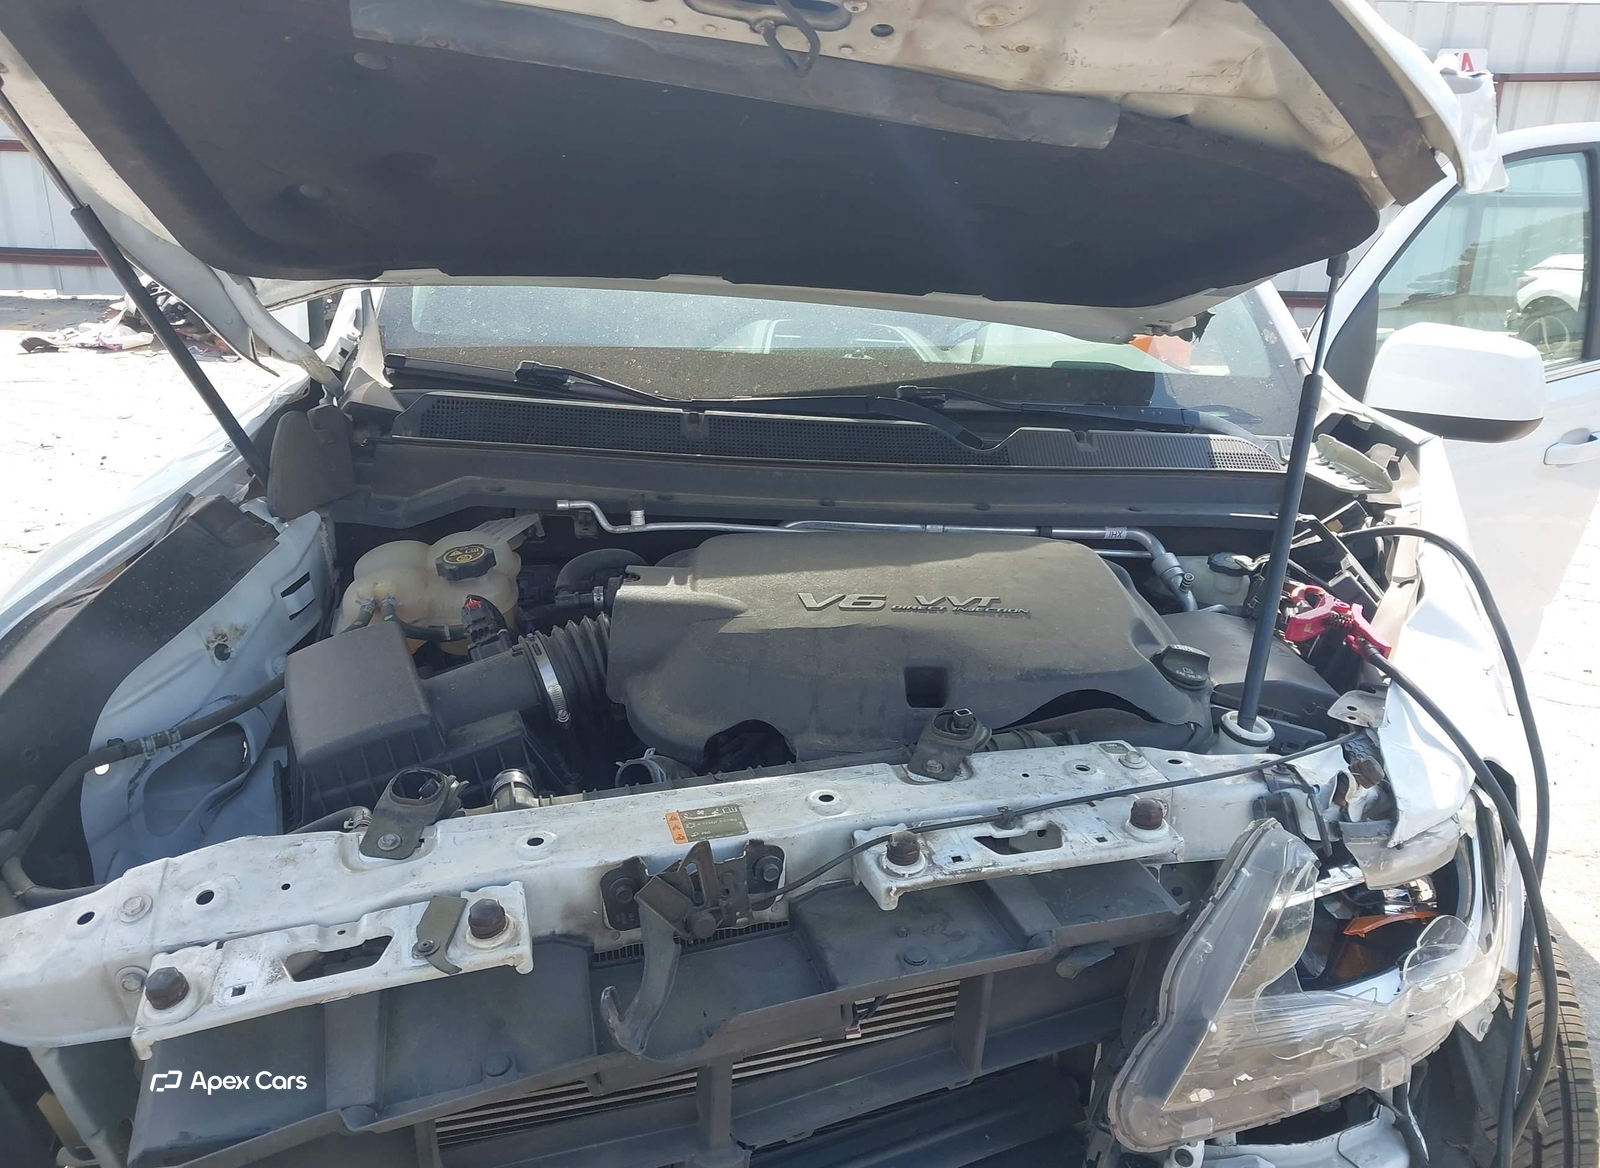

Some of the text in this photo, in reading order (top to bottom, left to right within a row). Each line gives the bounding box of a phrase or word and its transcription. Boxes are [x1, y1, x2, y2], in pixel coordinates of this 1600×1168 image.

[797, 592, 1001, 611] V6 VVT
[891, 604, 1031, 615] DIRECT INJECTION
